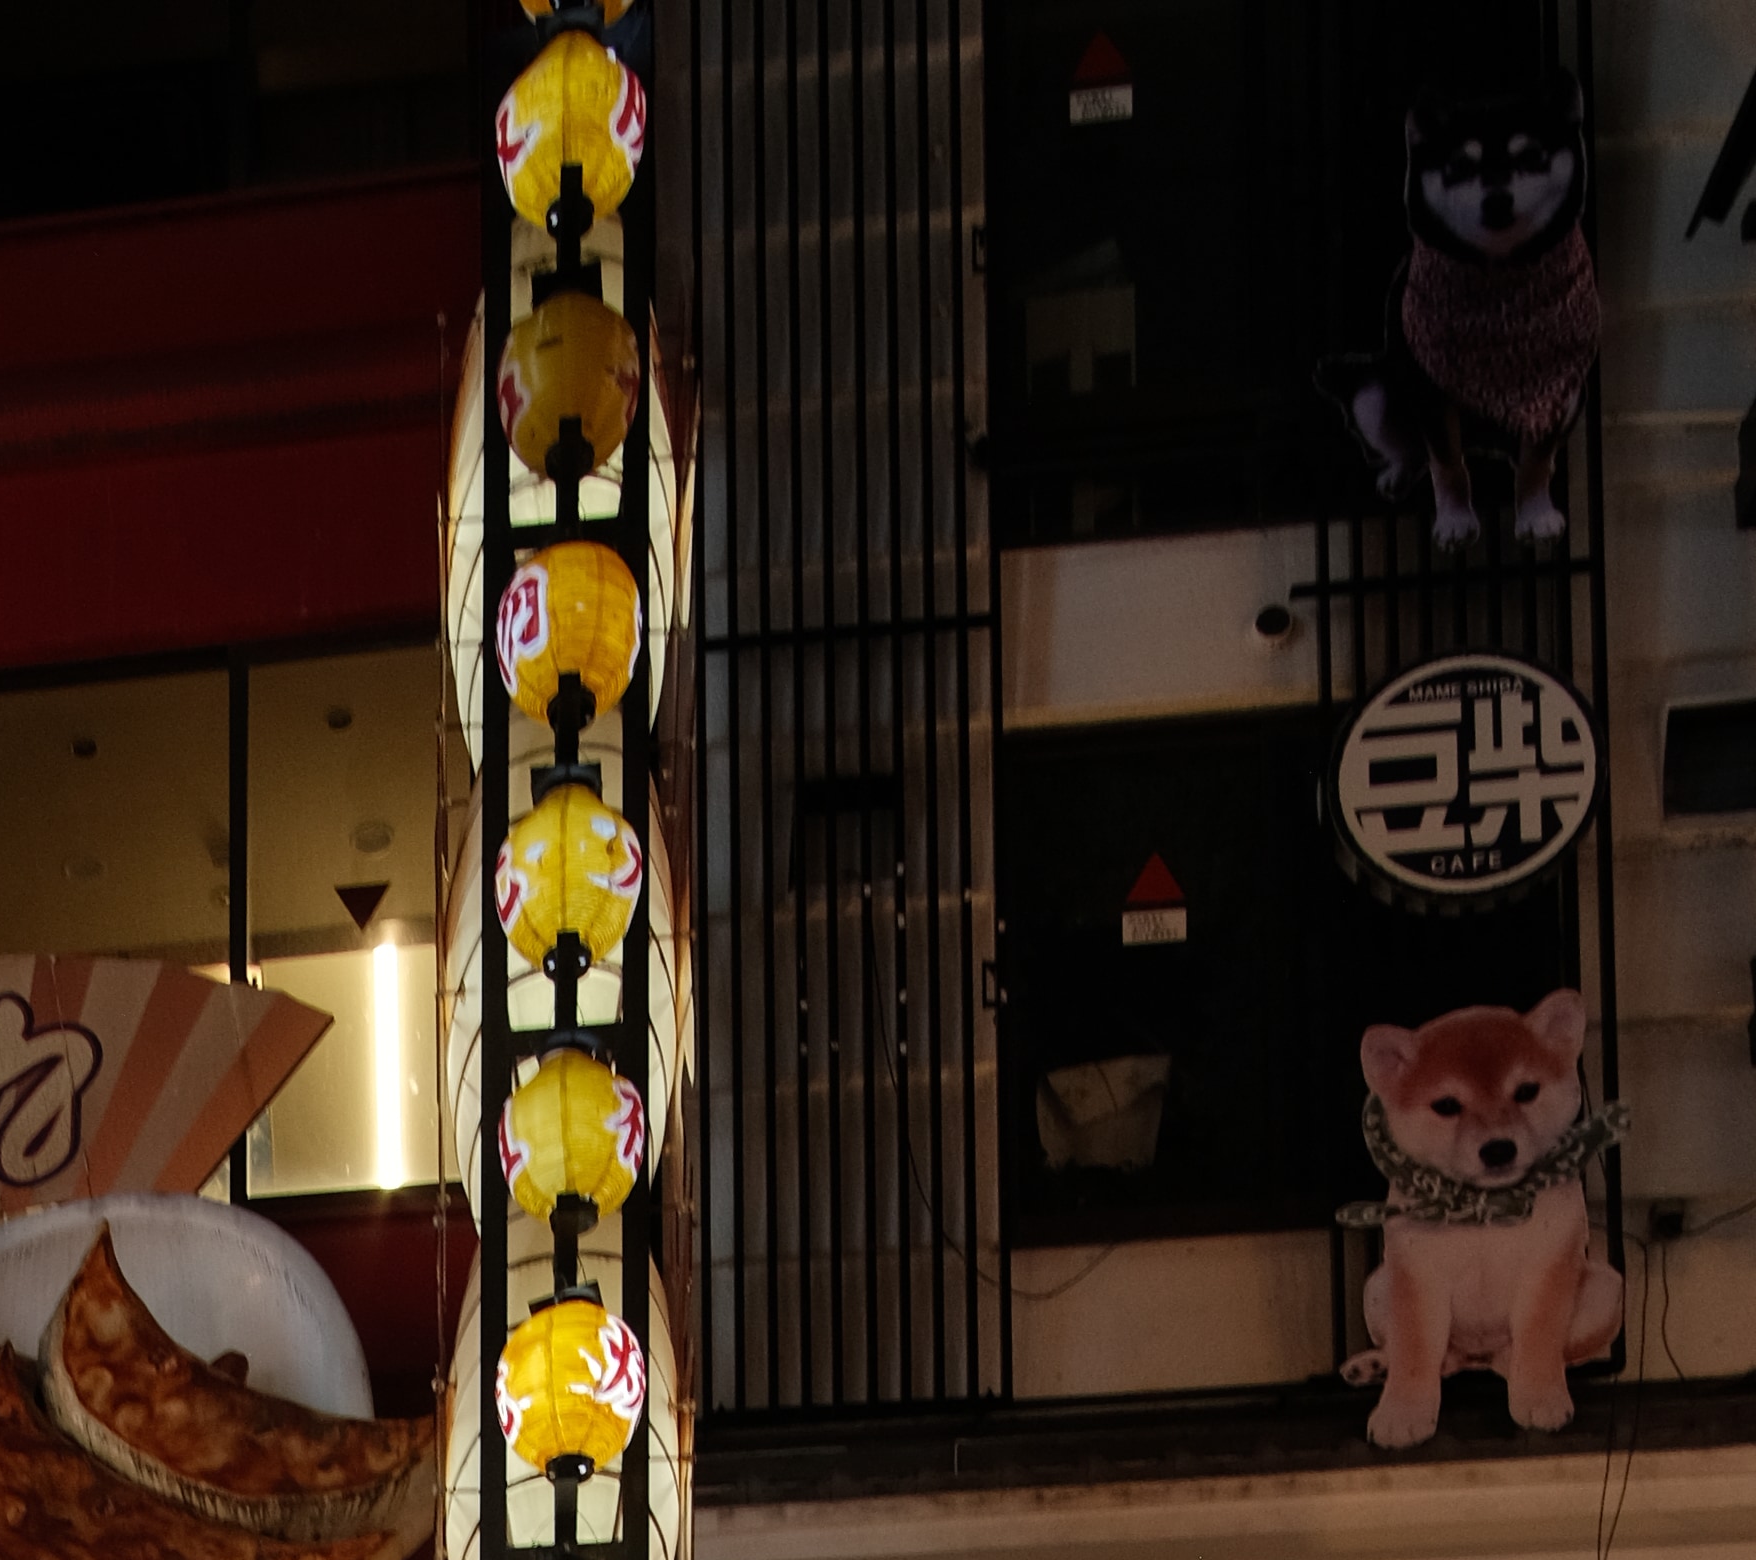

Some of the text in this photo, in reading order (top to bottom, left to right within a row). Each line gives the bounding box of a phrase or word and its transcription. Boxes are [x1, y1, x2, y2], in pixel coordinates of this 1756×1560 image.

[1408, 675, 1524, 702] MAME SHIBA
[1340, 690, 1594, 855] 豆柴
[1430, 850, 1503, 875] CAFE
